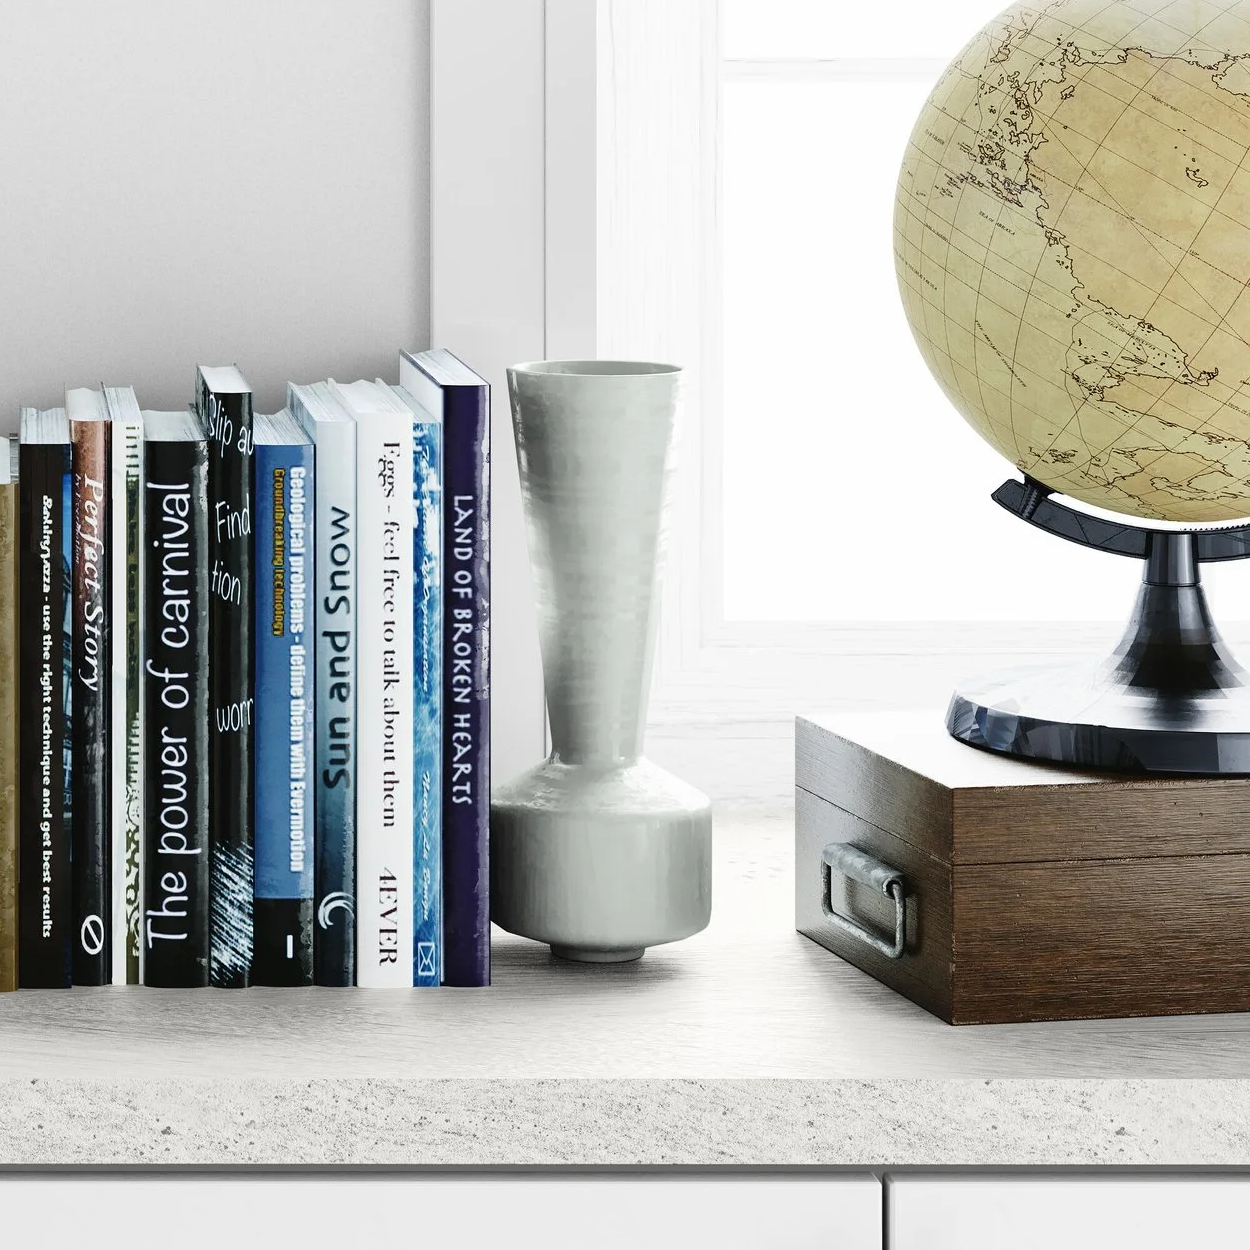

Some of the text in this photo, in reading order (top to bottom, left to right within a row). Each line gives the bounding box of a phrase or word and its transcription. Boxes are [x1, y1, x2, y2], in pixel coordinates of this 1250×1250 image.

[379, 442, 401, 498] Eggs
[215, 492, 251, 543] Find
[289, 466, 307, 554] Geological
[273, 468, 285, 636] Groundbreaking technology
[383, 520, 400, 561] feel
[78, 473, 106, 692] Perfect Story
[212, 560, 242, 606] tion
[288, 555, 307, 634] problems
[383, 568, 400, 613] free
[42, 604, 51, 632] use
[383, 619, 396, 643] to
[42, 634, 53, 661] the
[290, 644, 307, 697] define
[321, 506, 350, 791] Sun and Snow
[383, 649, 400, 691] talk
[452, 495, 474, 805] LAND OF BROKEN HEARTS
[39, 663, 53, 704] right
[146, 482, 202, 949] The power of carnival
[290, 698, 307, 741] them
[383, 697, 400, 762] about
[39, 705, 53, 786] technique
[290, 742, 307, 779] with
[42, 787, 53, 819] and
[383, 770, 400, 827] them
[39, 820, 52, 848] get
[290, 781, 307, 872] Evermotion
[42, 850, 53, 884] best
[42, 886, 53, 938] results
[378, 867, 398, 966] 4EVER
